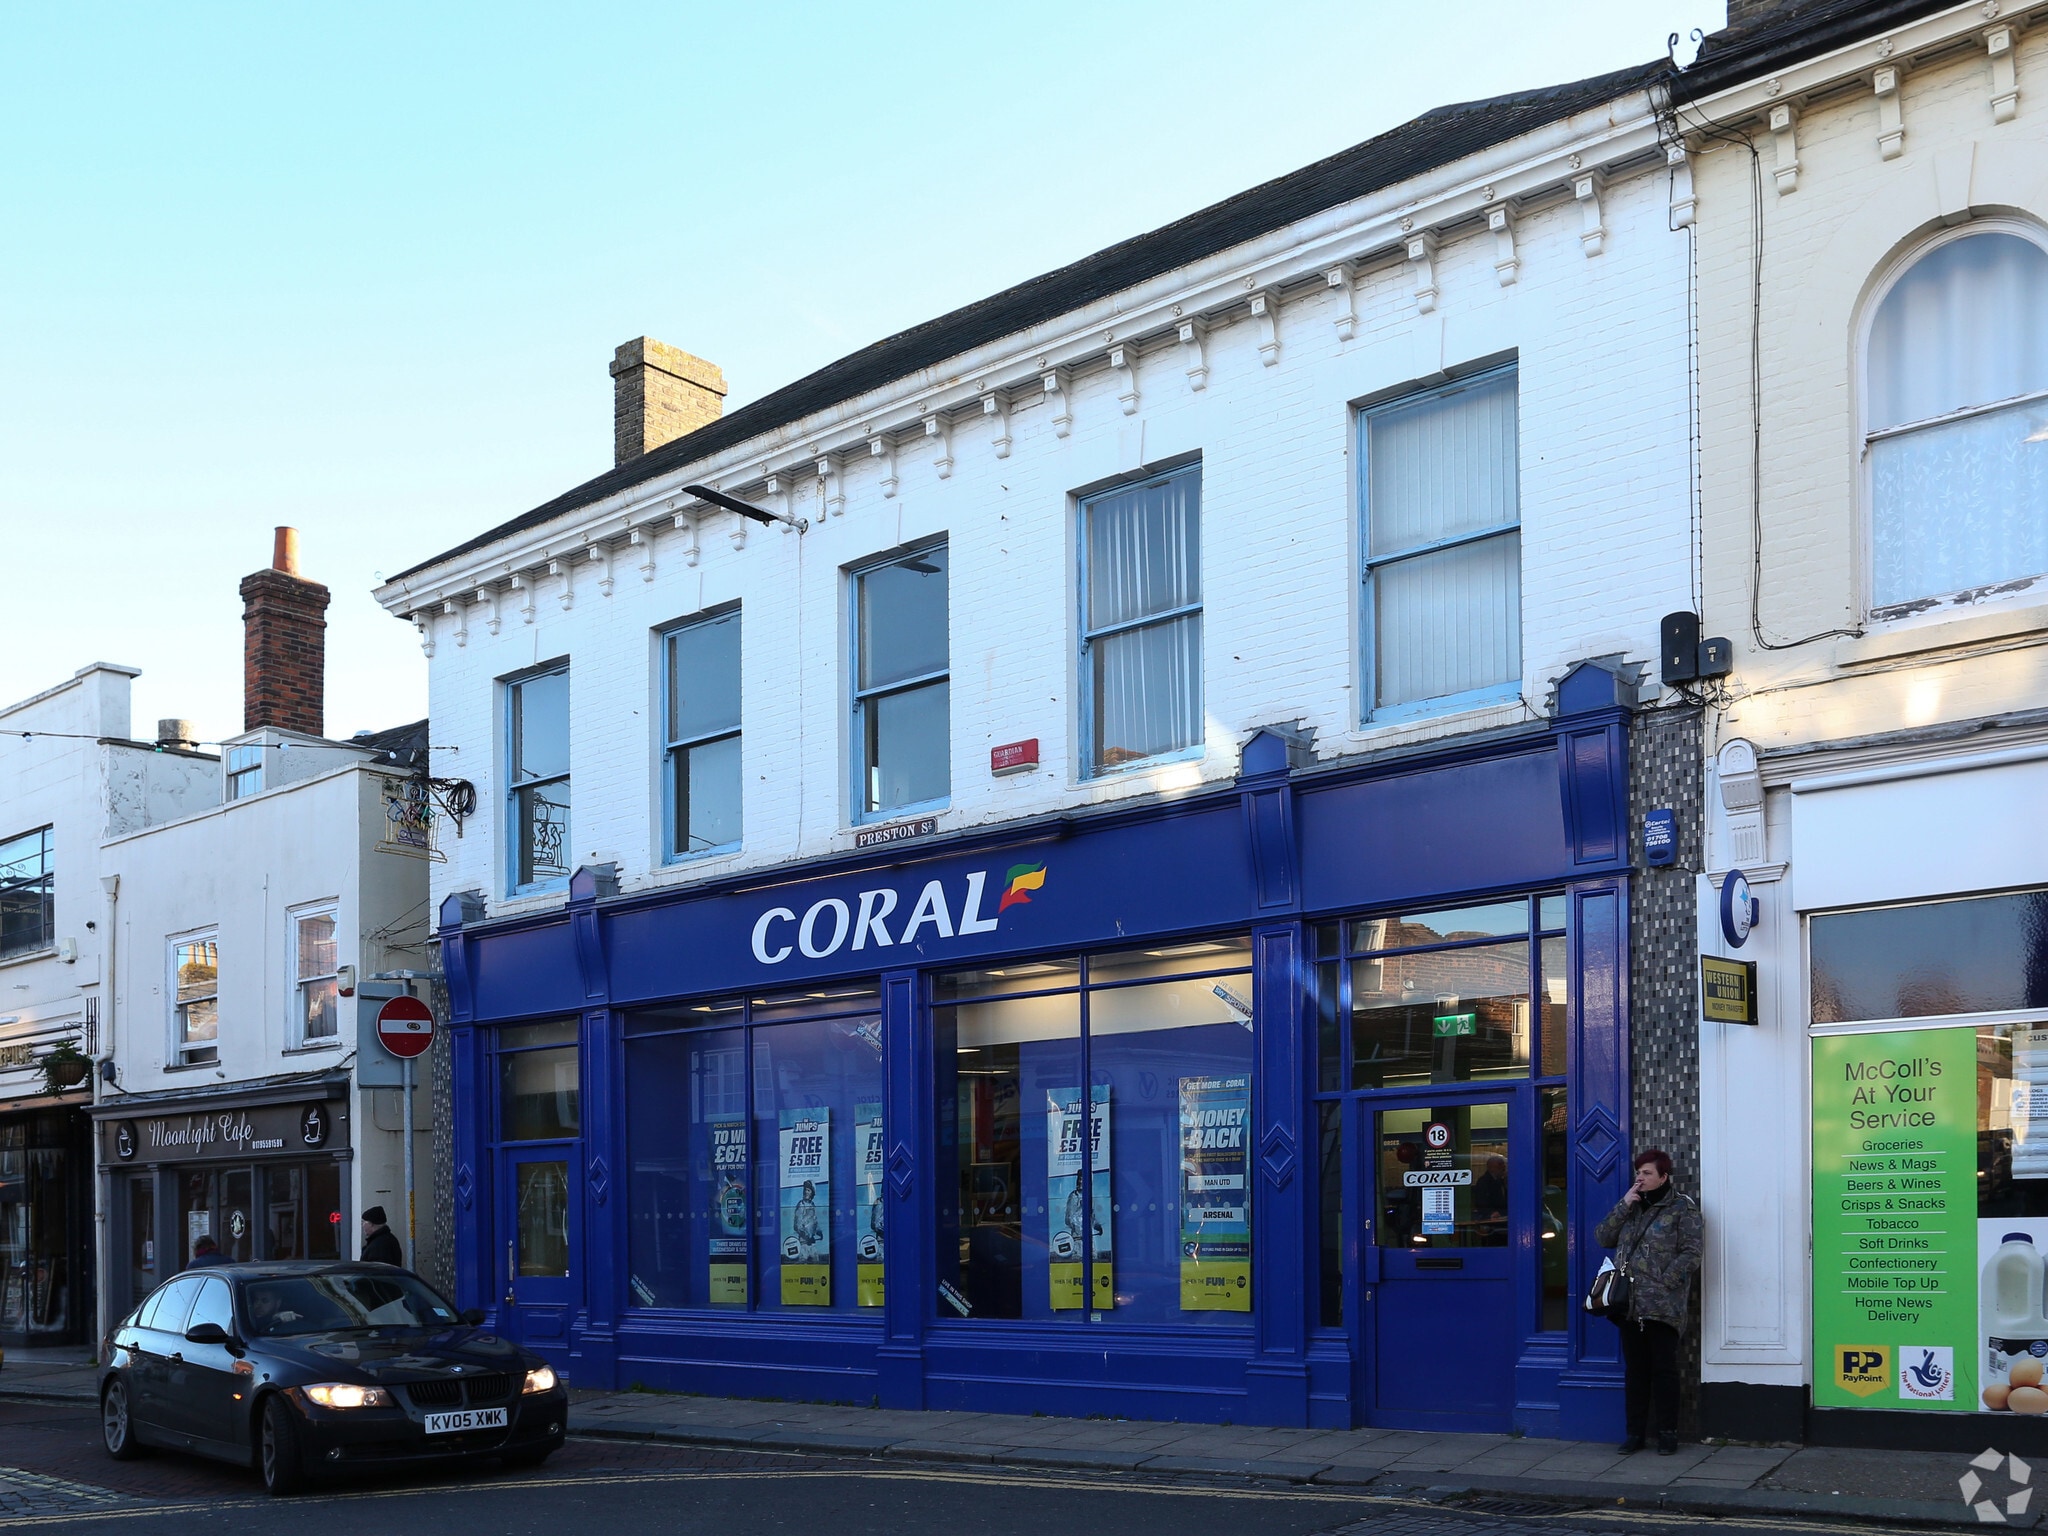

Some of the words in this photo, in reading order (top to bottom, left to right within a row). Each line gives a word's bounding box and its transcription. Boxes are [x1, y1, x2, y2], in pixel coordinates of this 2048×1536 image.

[993, 746, 1023, 759] GUARDIAN
[859, 824, 915, 847] PRESTON
[751, 871, 998, 964] CORAL
[1706, 971, 1739, 987] WESTERN
[1717, 986, 1739, 999] UNION
[1224, 995, 1252, 1017] SPORTS
[1711, 1002, 1725, 1011] MONEY
[1726, 1004, 1744, 1013] TRANSFER
[1845, 1057, 1942, 1081] McColl's
[1186, 1082, 1201, 1090] GET
[1201, 1081, 1221, 1089] MORE
[1226, 1079, 1245, 1088] CORAL
[1852, 1086, 1876, 1105] At
[1884, 1085, 1936, 1103] Your
[1190, 1108, 1246, 1127] MONEY
[1850, 1108, 1935, 1130] Service
[149, 1116, 216, 1153] Moonlight
[219, 1111, 254, 1151] Cafe
[795, 1122, 818, 1132] JUMPS
[1061, 1118, 1102, 1139] FRE
[714, 1130, 729, 1144] TO
[731, 1129, 746, 1143] WI
[867, 1133, 883, 1150] FR
[1188, 1127, 1243, 1149] BACK
[1430, 1130, 1445, 1141] 18
[791, 1136, 823, 1154] FREE
[1059, 1139, 1077, 1153] £5
[1862, 1139, 1923, 1151] Groceries
[789, 1154, 803, 1166] £5
[804, 1153, 821, 1165] BET
[865, 1151, 881, 1163] £5
[1850, 1160, 1884, 1171] News
[1888, 1159, 1897, 1170] &
[1902, 1158, 1937, 1172] Mags
[1406, 1172, 1461, 1184] CORAL
[1847, 1180, 1884, 1191] Beers
[1888, 1179, 1896, 1189] &
[1901, 1178, 1941, 1189] Wines
[1841, 1199, 1881, 1212] Crisps
[1885, 1198, 1894, 1209] &
[1898, 1198, 1946, 1209] Snacks
[329, 1212, 342, 1223] OP
[1866, 1218, 1919, 1229] Tobacco
[1859, 1238, 1884, 1249] Soft
[1888, 1238, 1929, 1249] Drinks
[1849, 1258, 1937, 1271] Confectionery
[800, 1277, 813, 1285] FUN
[1073, 1277, 1083, 1286] FU
[1205, 1277, 1225, 1286] FUN
[1847, 1277, 1889, 1288] Mobile
[1893, 1277, 1917, 1290] Top
[1920, 1277, 1939, 1290] Up
[1855, 1297, 1892, 1308] Home
[1896, 1297, 1933, 1308] News
[1868, 1310, 1919, 1323] Delivery
[1843, 1374, 1882, 1383] PayPoint
[1905, 1383, 1935, 1397] National
[1935, 1371, 1951, 1394] Lottery
[431, 1413, 472, 1431] KV05
[476, 1410, 502, 1426] XWK
